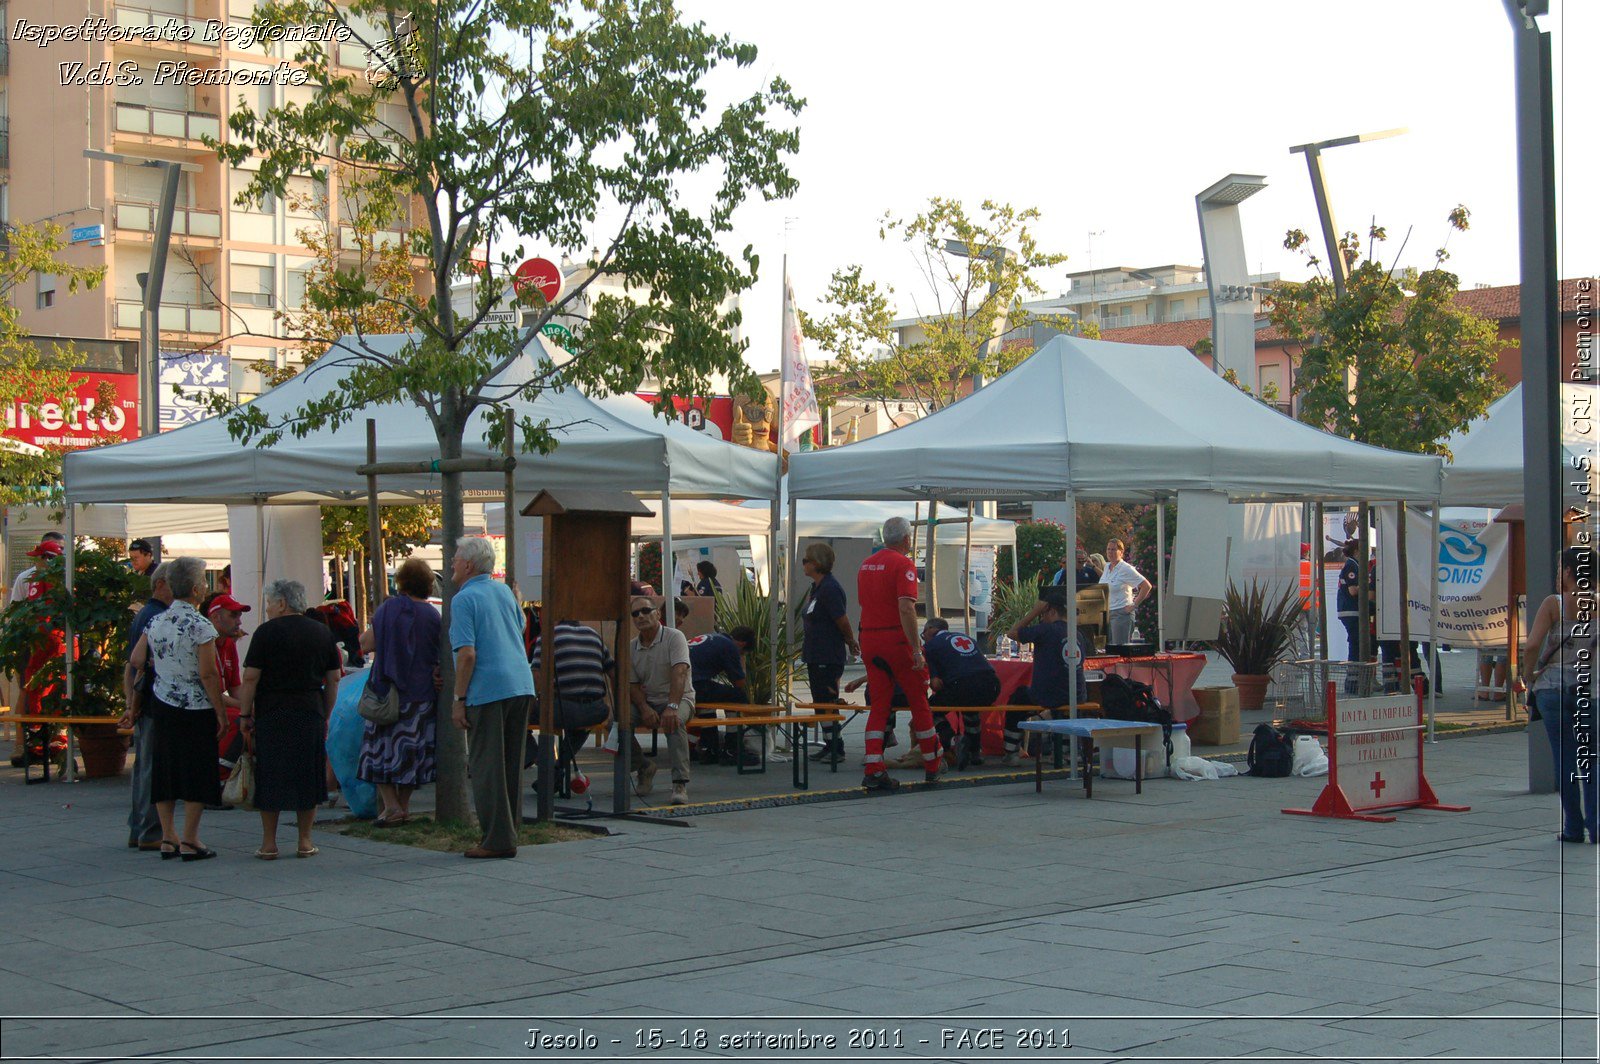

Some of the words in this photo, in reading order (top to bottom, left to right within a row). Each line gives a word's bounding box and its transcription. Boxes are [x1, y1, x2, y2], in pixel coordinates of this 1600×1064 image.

[1438, 567, 1483, 583] OMIS
[1440, 608, 1451, 618] di
[1358, 747, 1397, 760] ITALIANA
